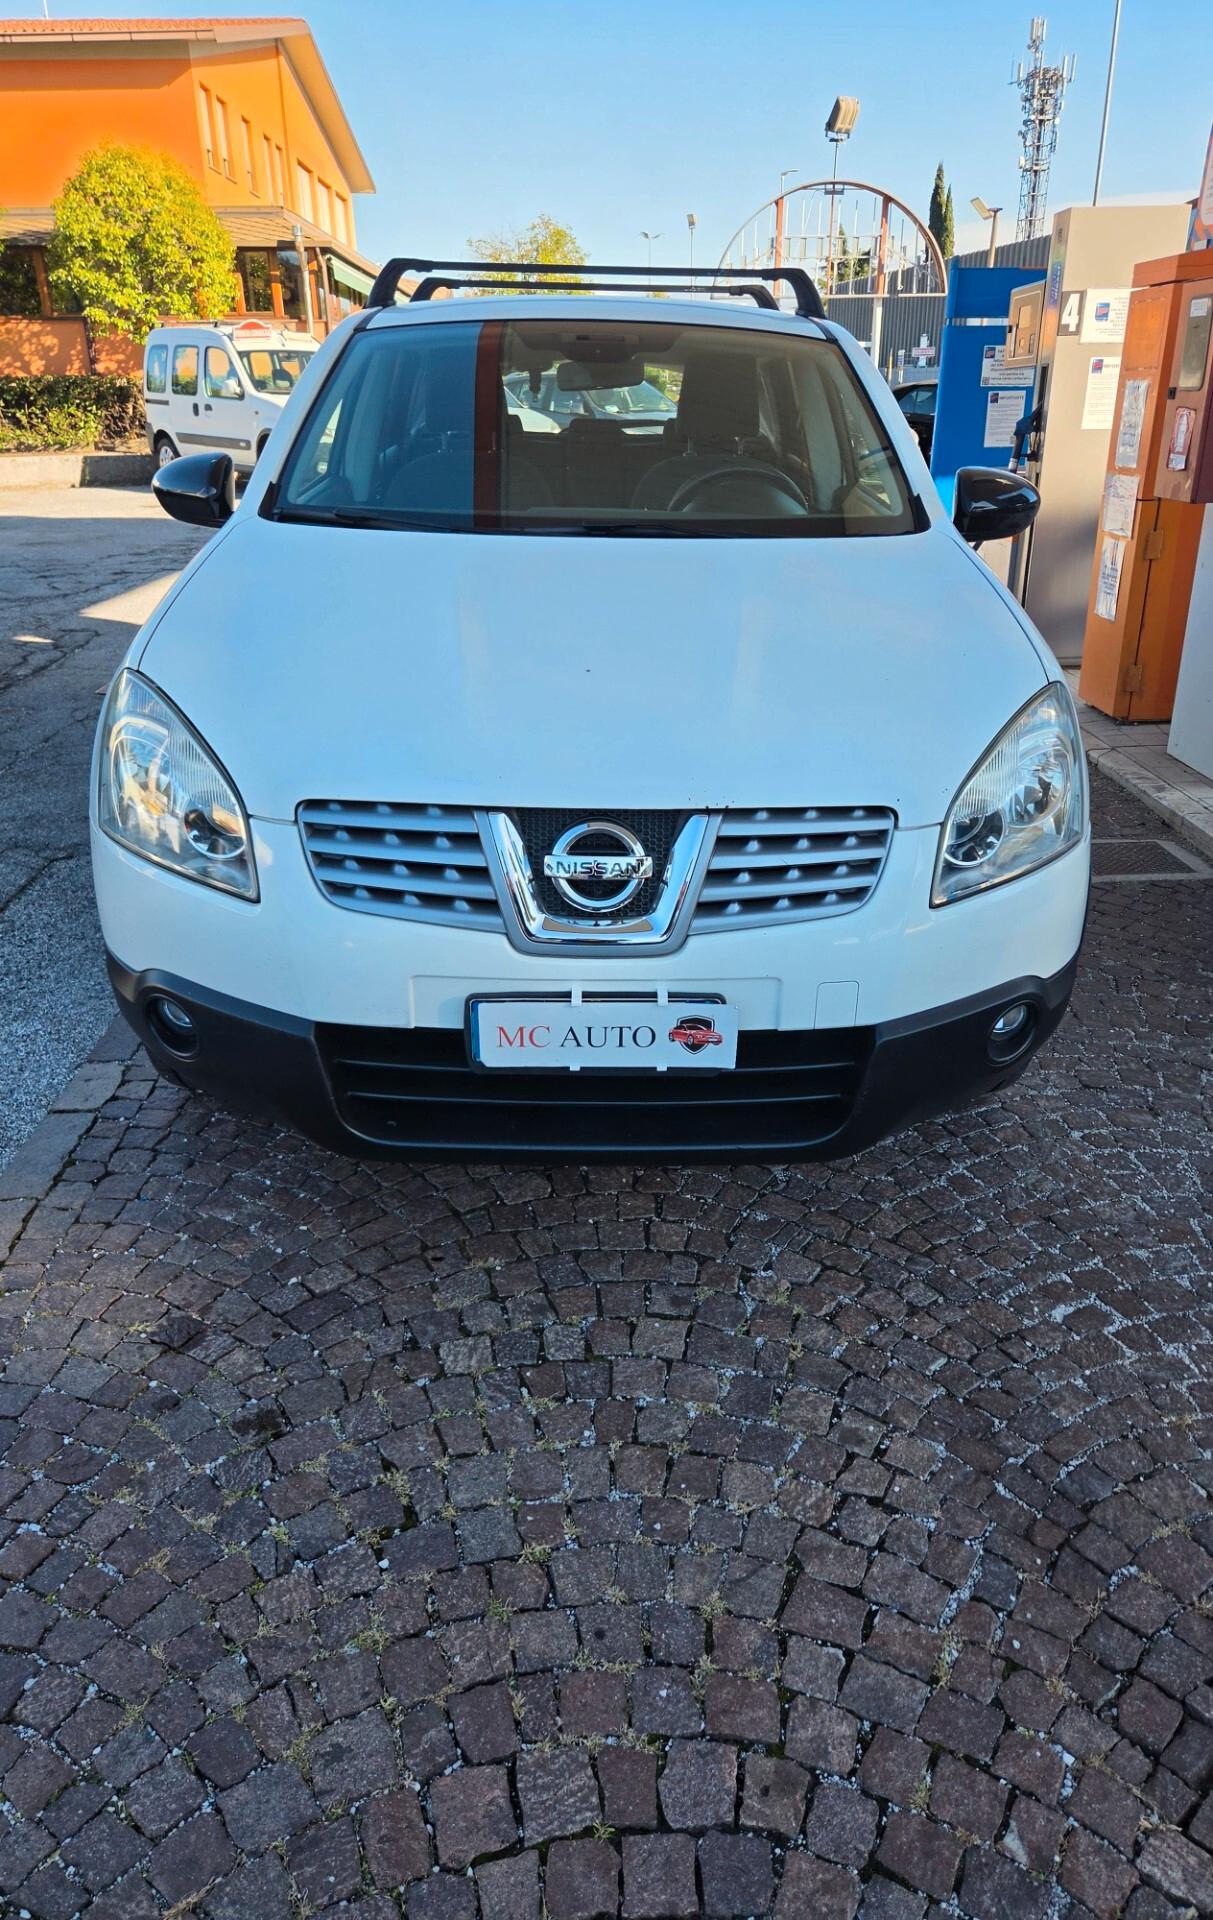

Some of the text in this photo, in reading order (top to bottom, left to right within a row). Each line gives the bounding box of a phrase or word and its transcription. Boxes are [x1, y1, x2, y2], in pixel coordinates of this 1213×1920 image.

[1061, 293, 1080, 332] 4
[555, 860, 642, 877] NISSAN
[496, 1025, 656, 1048] MC AUTO
